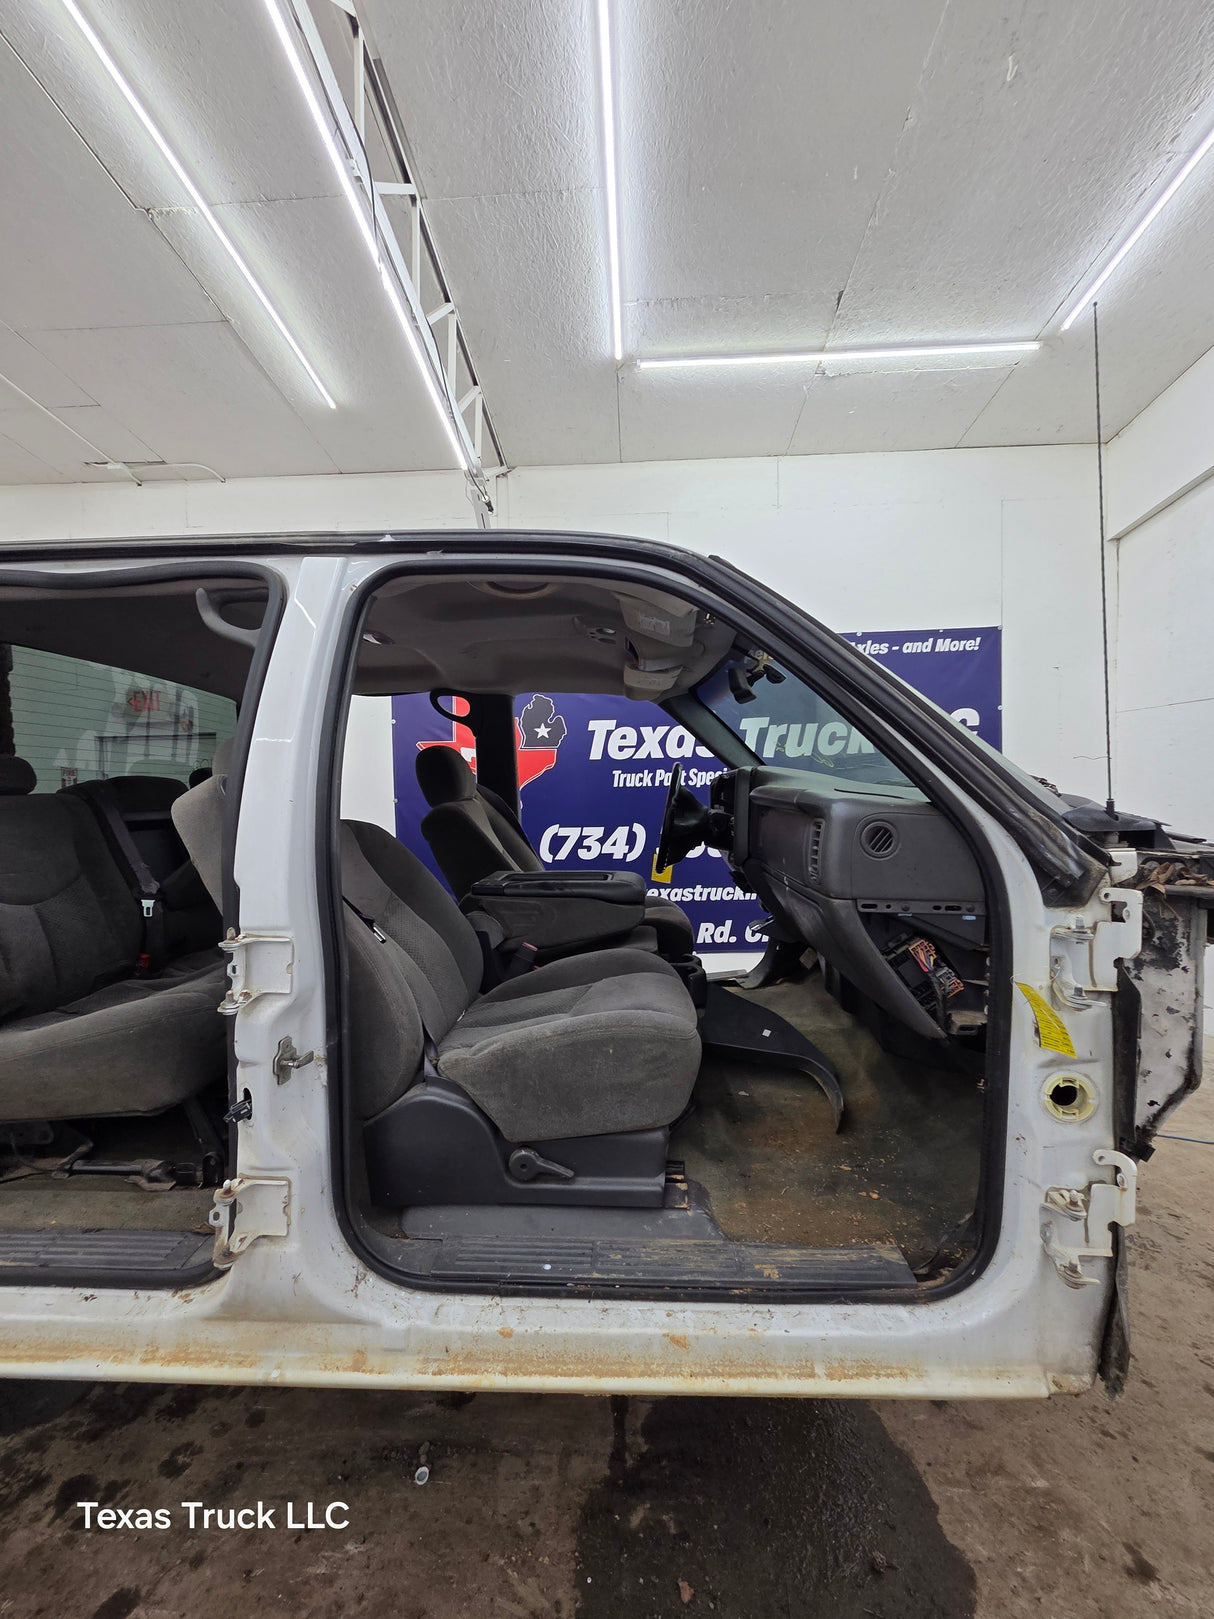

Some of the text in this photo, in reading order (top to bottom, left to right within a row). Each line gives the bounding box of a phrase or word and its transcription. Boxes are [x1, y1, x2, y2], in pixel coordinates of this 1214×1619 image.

[902, 638, 933, 653] and
[935, 637, 981, 652] More!
[612, 769, 652, 787] Truck
[655, 769, 686, 787] Pat
[539, 823, 646, 863] (734)
[696, 920, 737, 943] Rd.
